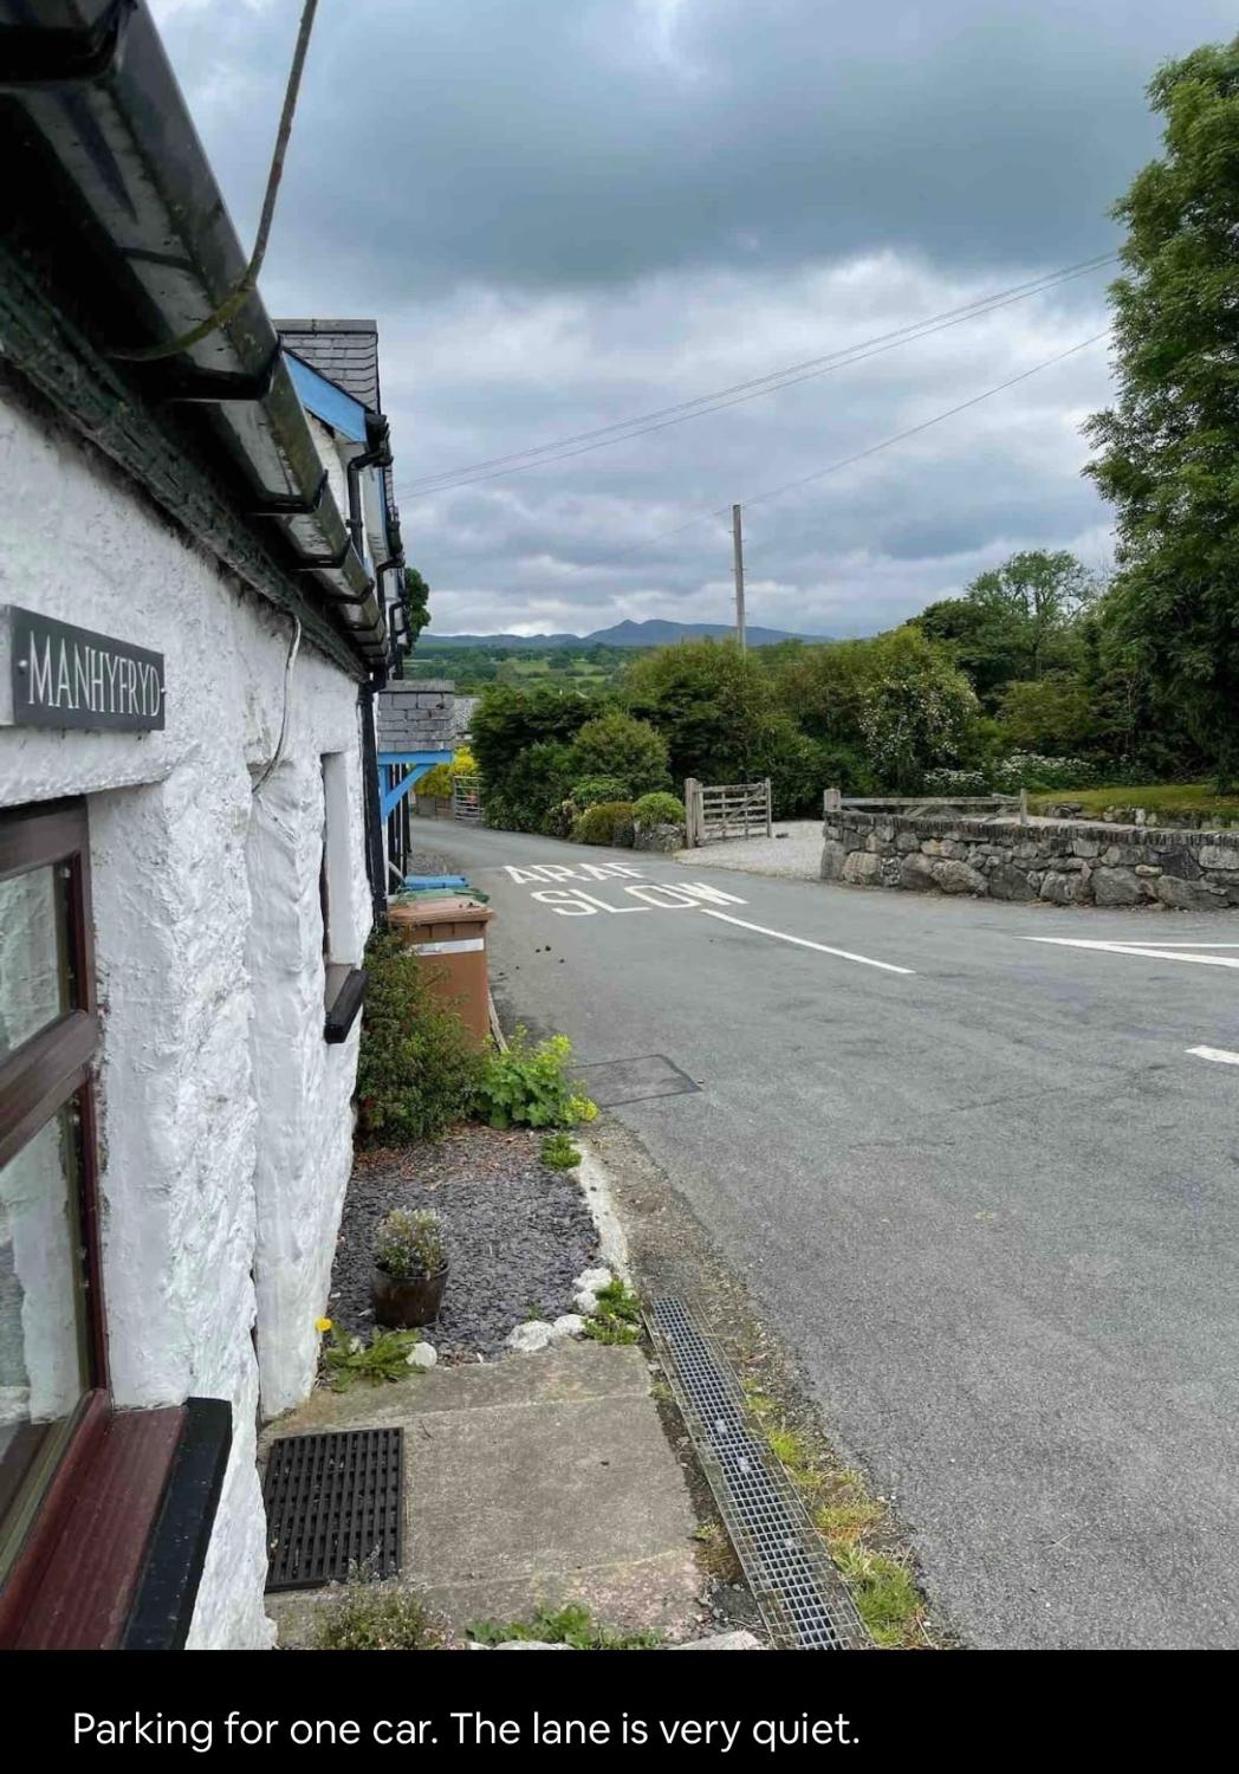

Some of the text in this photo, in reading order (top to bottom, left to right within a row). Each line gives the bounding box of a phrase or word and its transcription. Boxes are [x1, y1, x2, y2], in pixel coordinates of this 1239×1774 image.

[28, 630, 161, 717] MANHYFRYD
[502, 862, 644, 884] ARAF
[530, 882, 749, 916] SLOW
